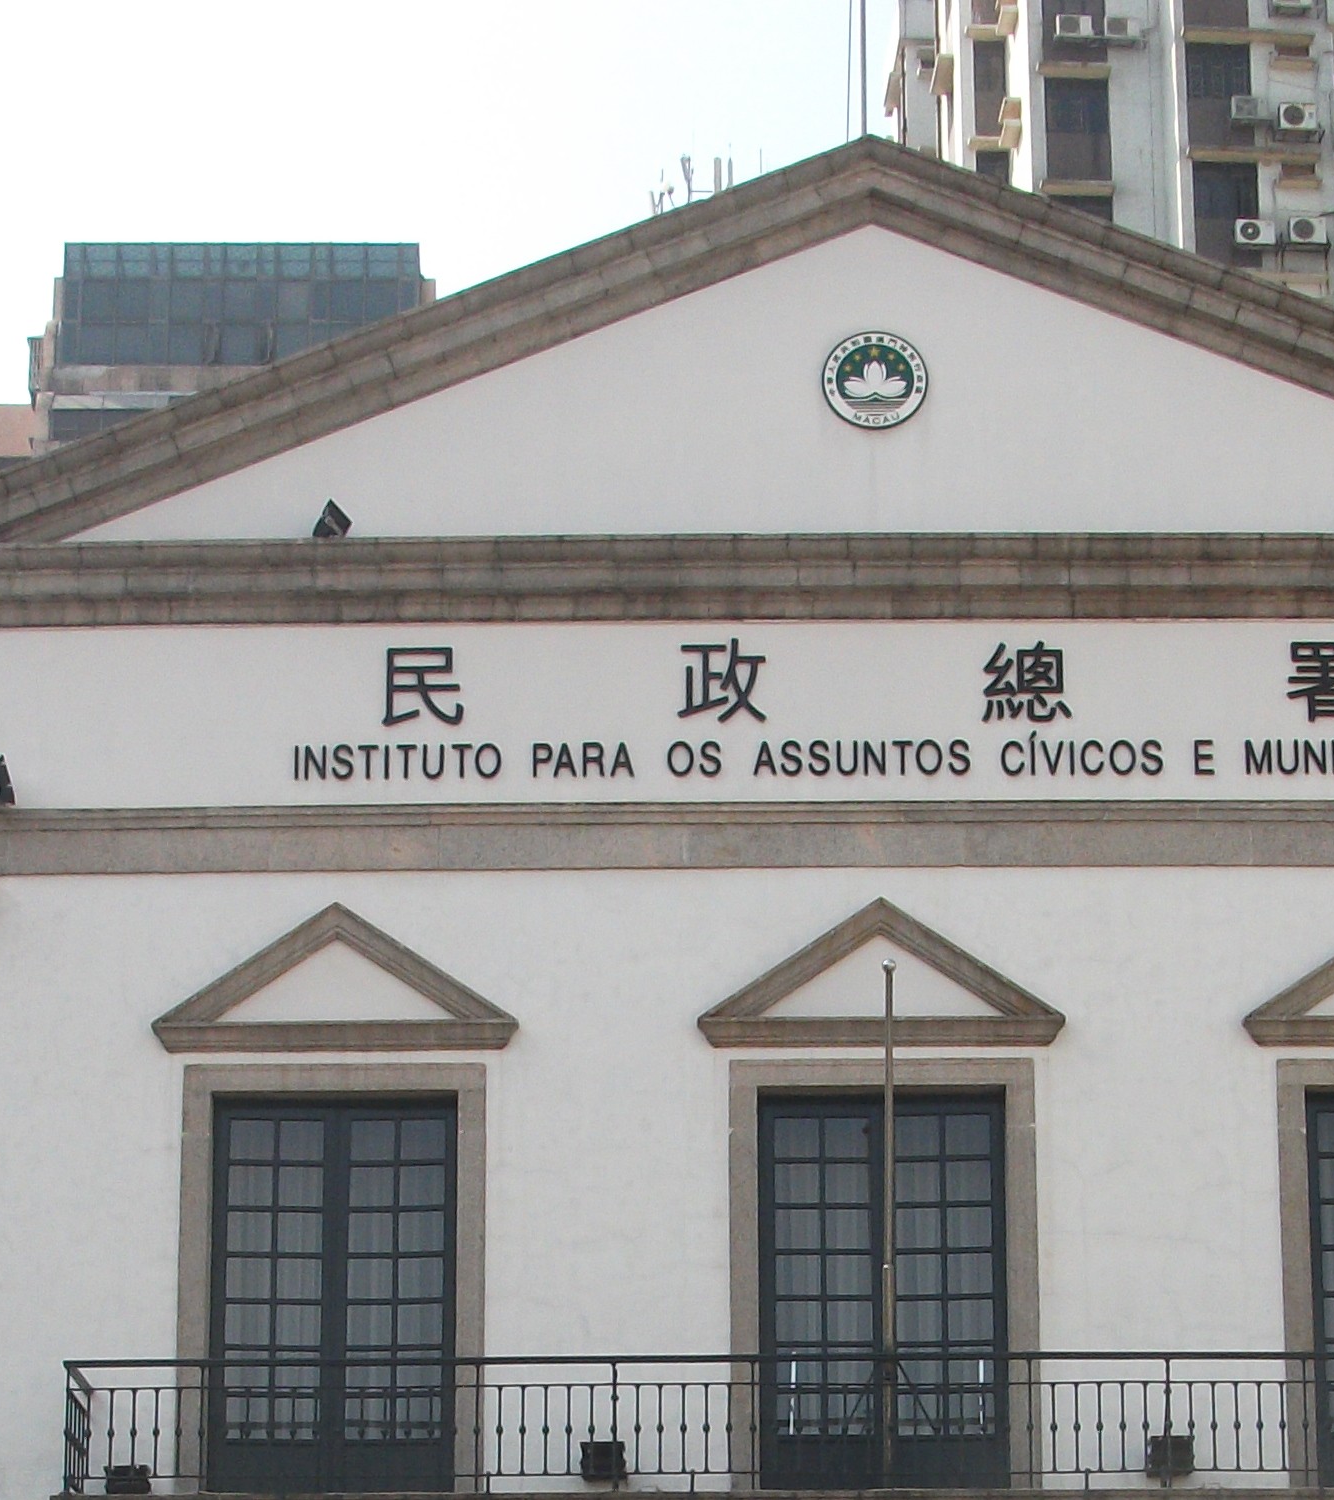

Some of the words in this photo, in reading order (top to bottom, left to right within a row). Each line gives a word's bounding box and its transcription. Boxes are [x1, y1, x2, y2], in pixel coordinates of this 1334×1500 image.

[852, 411, 900, 425] MACAU
[292, 743, 503, 781] INSTITUTO
[531, 741, 636, 778] PARA
[667, 740, 723, 778] OS
[752, 738, 972, 777] ASSUNTOS
[1000, 729, 1165, 777] CÍVICOS
[1193, 739, 1216, 776] E
